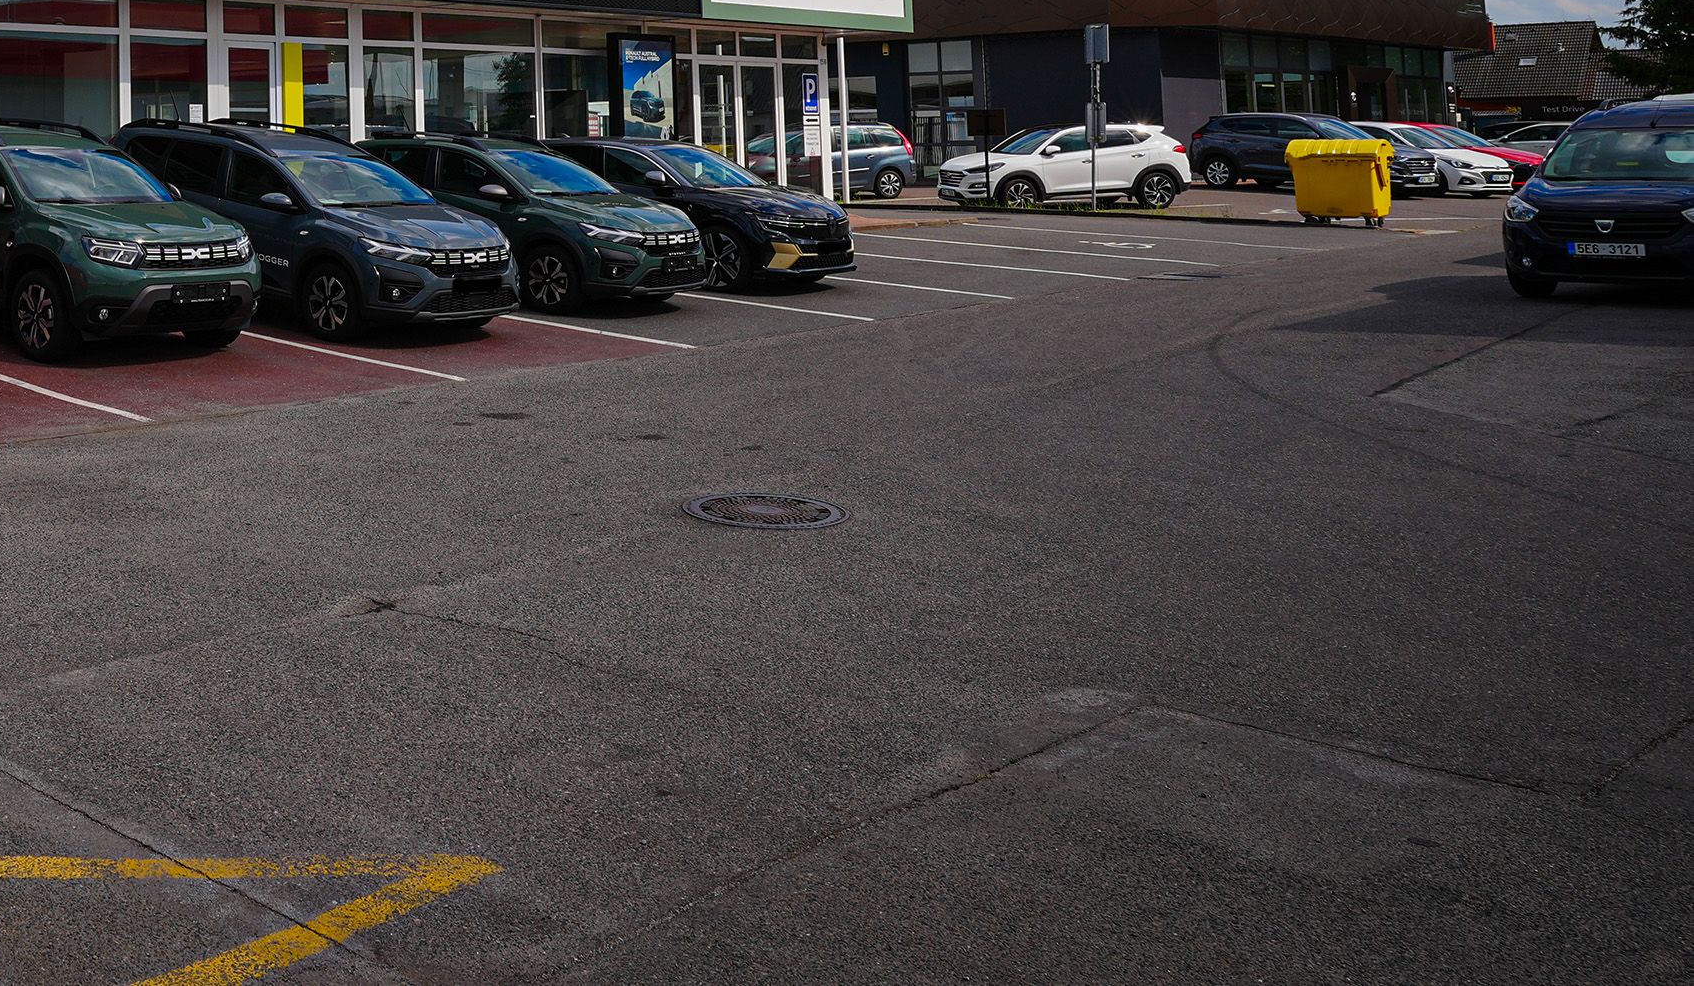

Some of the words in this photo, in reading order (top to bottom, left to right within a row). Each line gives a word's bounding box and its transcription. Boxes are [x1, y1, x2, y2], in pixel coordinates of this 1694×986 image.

[806, 78, 816, 103] P
[1577, 243, 1600, 254] 5E6
[1609, 244, 1640, 255] 3121
